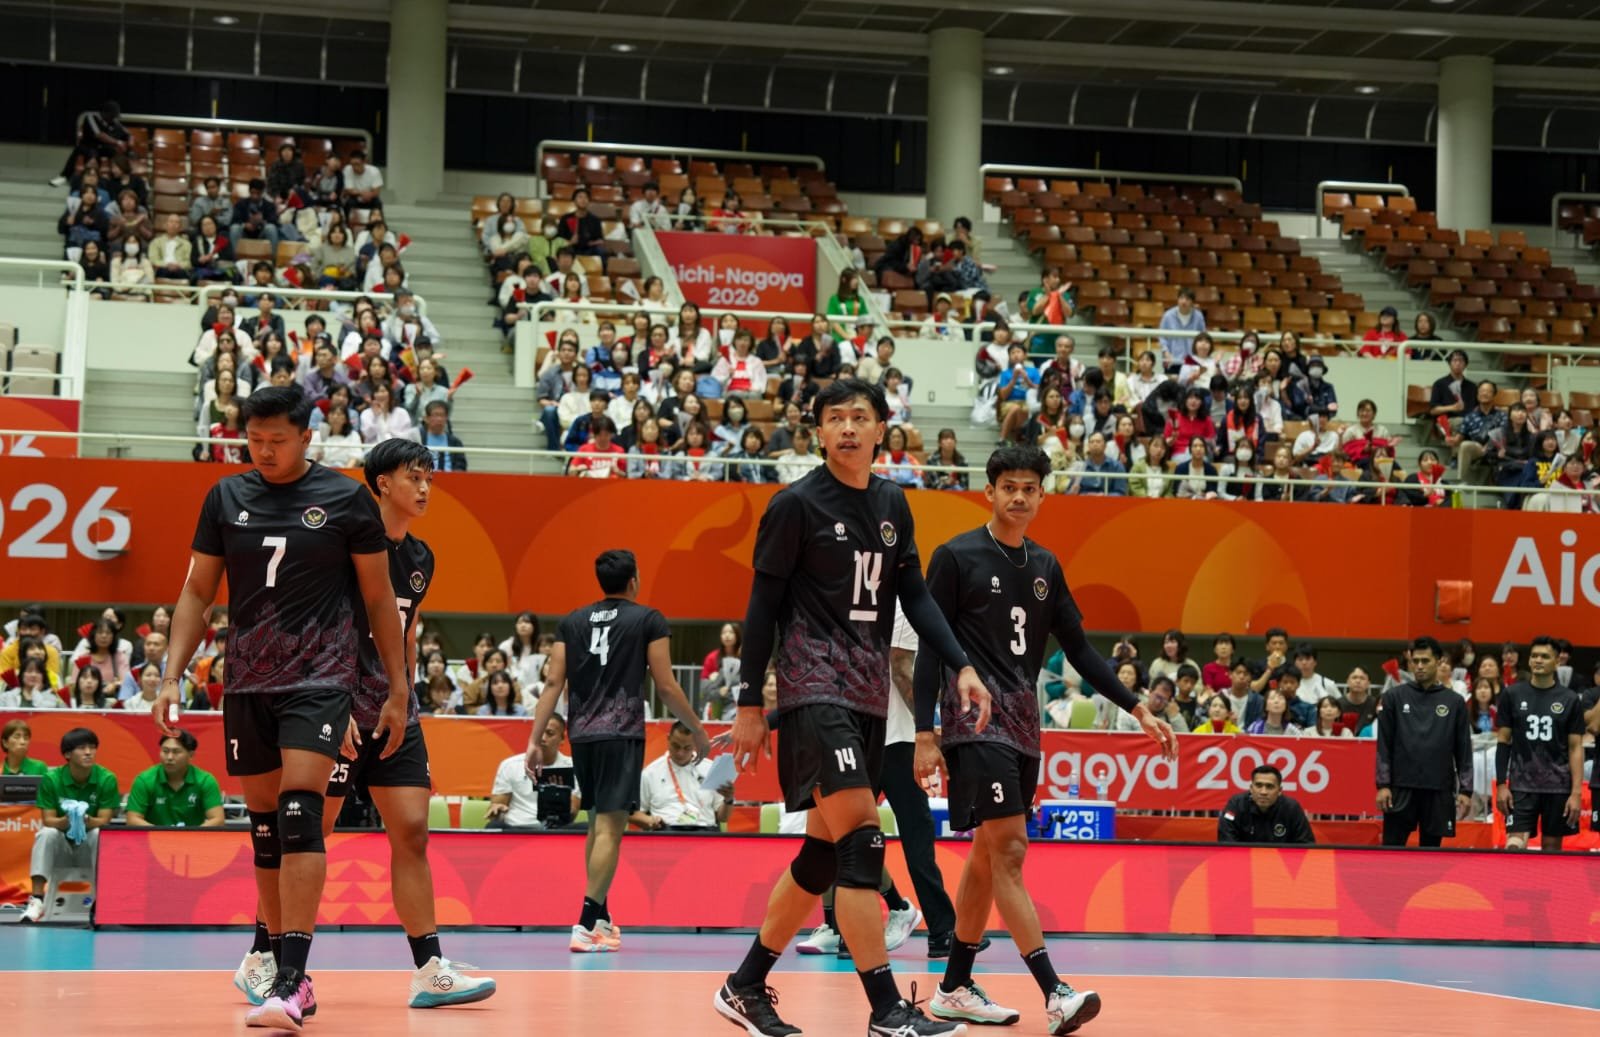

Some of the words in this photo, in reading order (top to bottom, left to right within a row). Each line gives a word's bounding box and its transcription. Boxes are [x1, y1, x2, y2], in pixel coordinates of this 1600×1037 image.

[708, 287, 759, 305] 2026
[0, 483, 131, 560] 26
[262, 536, 287, 588] 7
[853, 550, 883, 606] 14
[589, 626, 611, 666] 4
[1010, 606, 1027, 656] 3
[1525, 714, 1553, 741] 33
[230, 739, 239, 760] 7
[834, 747, 857, 772] 14
[329, 763, 350, 783] 25
[1038, 751, 1179, 802] goya
[1196, 746, 1330, 793] 2026
[991, 782, 1005, 804] 3
